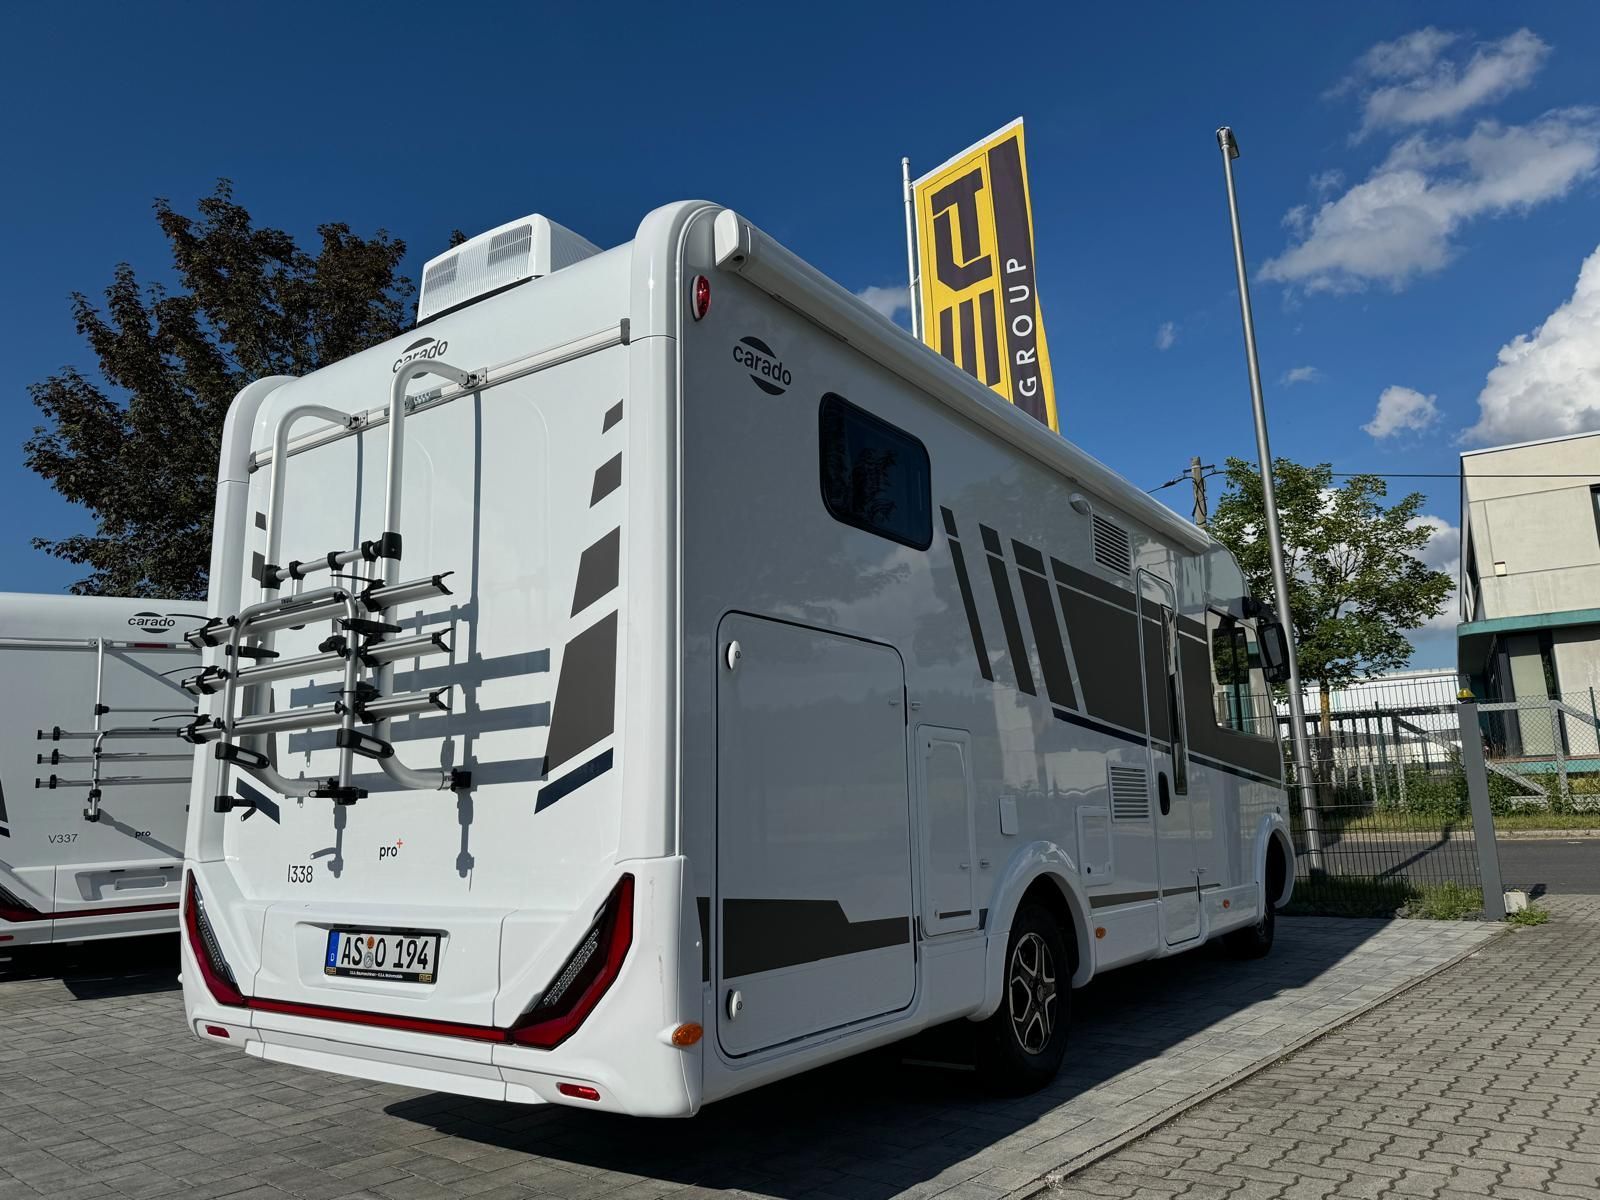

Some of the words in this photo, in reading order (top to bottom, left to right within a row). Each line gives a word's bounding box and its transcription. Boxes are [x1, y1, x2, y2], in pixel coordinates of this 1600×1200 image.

[1006, 257, 1037, 397] GROUP
[733, 345, 792, 386] carado
[128, 617, 176, 627] carado
[48, 833, 79, 844] V337
[135, 830, 151, 840] pro
[341, 936, 364, 966] AS
[393, 938, 429, 970] 194
